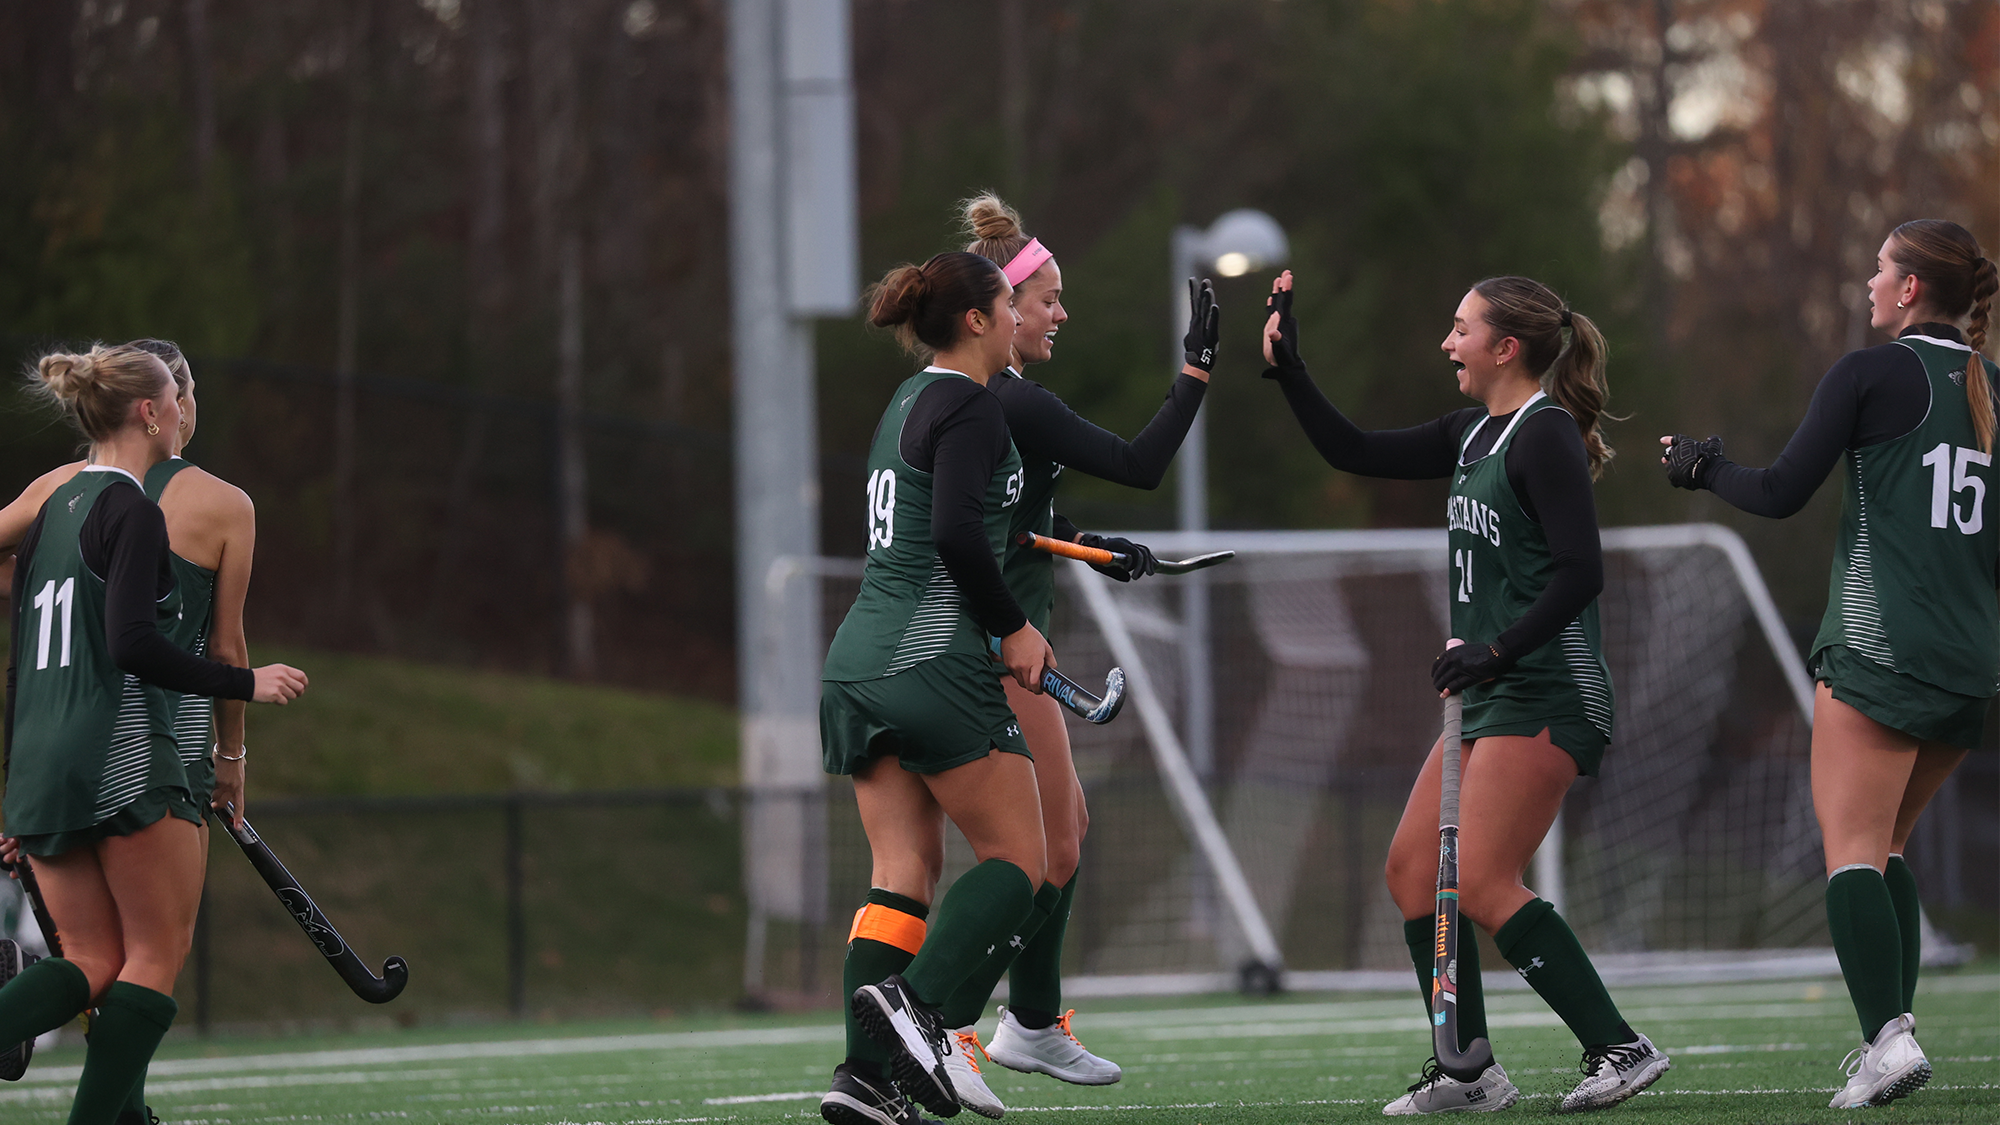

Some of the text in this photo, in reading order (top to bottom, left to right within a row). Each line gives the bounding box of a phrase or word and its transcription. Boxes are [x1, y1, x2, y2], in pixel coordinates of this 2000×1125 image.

[867, 468, 897, 550] 19
[1922, 442, 1993, 535] 15
[34, 577, 75, 671] 11
[1043, 672, 1076, 708] RIVAL
[1437, 913, 1450, 958] ritual
